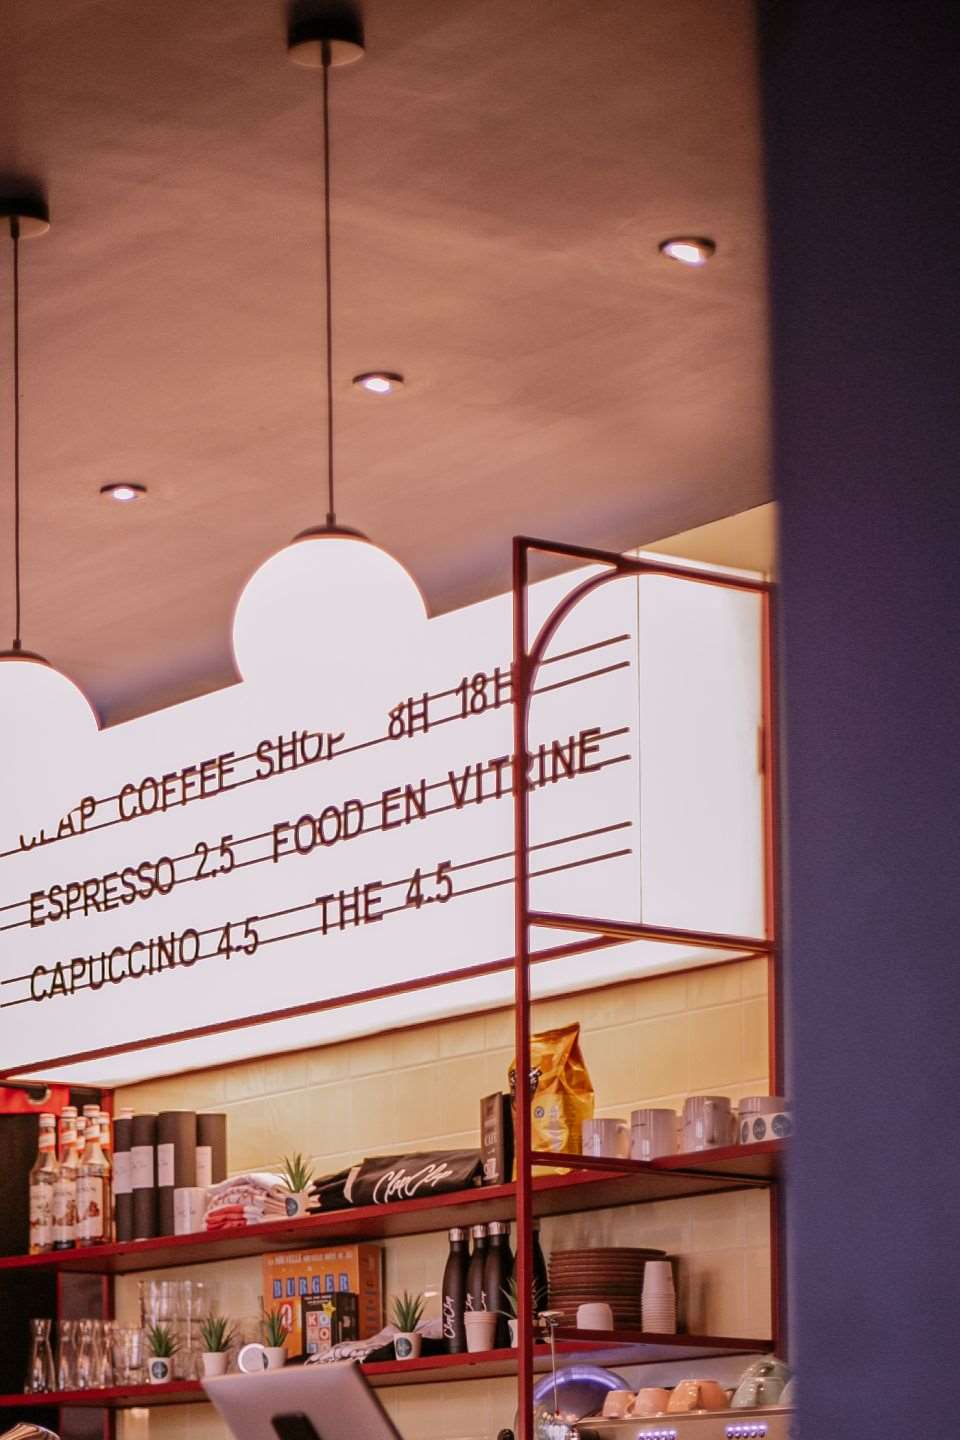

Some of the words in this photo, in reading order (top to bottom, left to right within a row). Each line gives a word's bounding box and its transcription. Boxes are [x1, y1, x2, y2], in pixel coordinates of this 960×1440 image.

[118, 751, 235, 821] COFFEE
[388, 692, 429, 741] 8H
[30, 856, 174, 928] ESPRESSO
[273, 799, 364, 863] FOOD
[382, 779, 426, 831] EN
[30, 928, 200, 1002] CAPUCCINO
[218, 916, 259, 960] 4.5
[316, 881, 383, 935] THE
[406, 860, 453, 909] 4.5
[272, 1273, 349, 1299] BURGER
